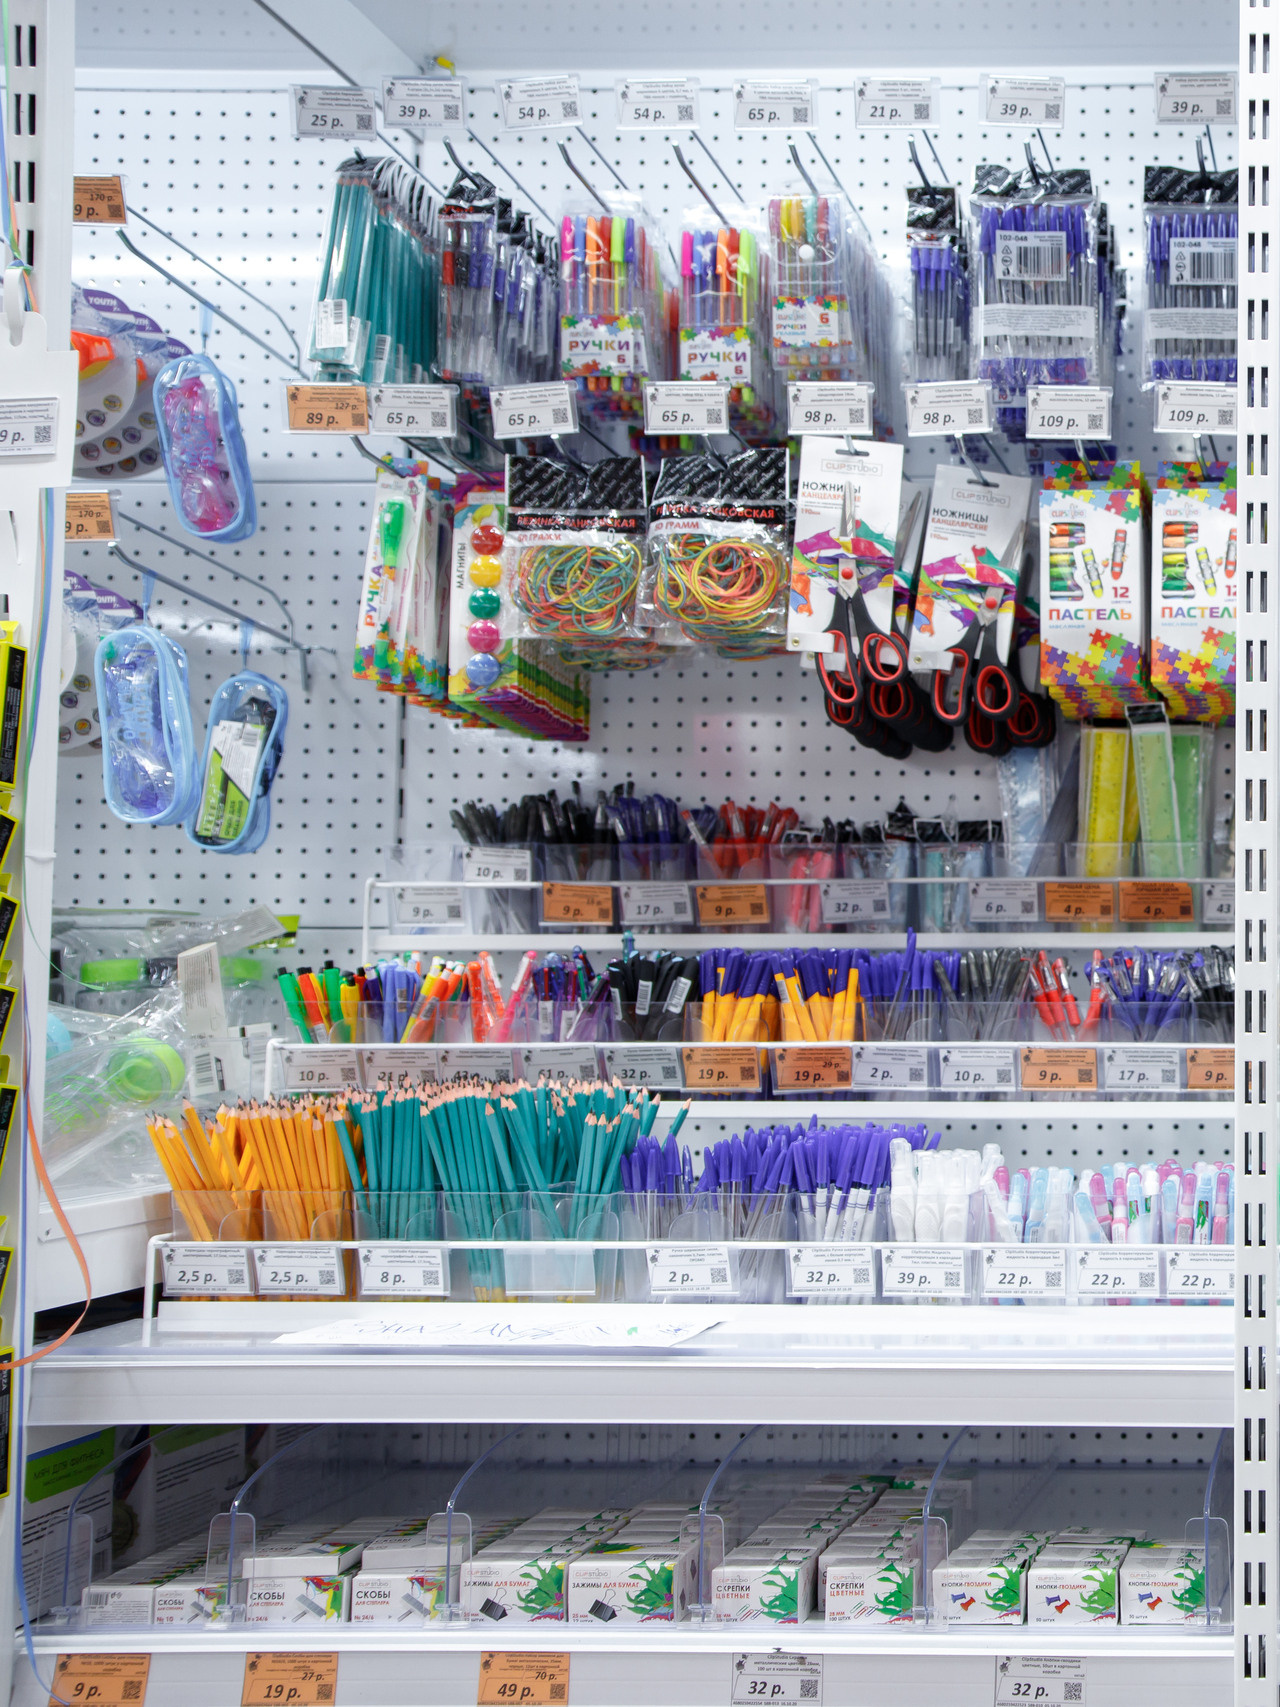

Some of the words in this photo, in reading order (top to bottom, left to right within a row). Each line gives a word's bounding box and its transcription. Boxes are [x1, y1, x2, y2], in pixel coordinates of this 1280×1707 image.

[399, 105, 415, 117] 39
[419, 109, 430, 120] р.
[634, 108, 649, 120] 54
[653, 110, 665, 122] р.
[870, 106, 884, 117] 21
[889, 109, 901, 120] р.
[1172, 101, 1188, 113] 39
[1191, 104, 1203, 115] р.
[88, 296, 117, 306] YOUTH
[569, 340, 630, 351] РУЧКИ
[616, 354, 626, 363] 6
[687, 352, 747, 363] РУЧКИ
[734, 366, 743, 375] 6
[306, 412, 323, 424] 89
[326, 416, 338, 427] р.
[387, 412, 403, 424] 65
[406, 416, 418, 426] р.
[805, 411, 821, 422] 98
[824, 413, 836, 424] р.
[1039, 415, 1063, 427] 109
[1066, 418, 1078, 430] р.
[826, 460, 878, 474] CLIPSTUDIO
[802, 481, 861, 493] НОЖНИЫ
[956, 490, 1006, 505] CLIPSTUDIO
[933, 508, 988, 523] НОЖНИЦЫ
[665, 521, 699, 530] ГРАММ
[932, 517, 988, 531] КАНЦЕЛЯРСКИЕ
[456, 542, 466, 589] МАГНИТЫ
[364, 565, 383, 627] РУЧКА
[1112, 587, 1129, 598] 12
[1049, 608, 1132, 621] ПАСТЕЛЬ
[637, 905, 650, 915] 17
[653, 906, 663, 916] р.
[300, 1070, 314, 1081] 10
[318, 1072, 329, 1083] р.
[955, 1071, 970, 1081] 10
[973, 1073, 984, 1083] р.
[178, 1270, 199, 1284] 2,5
[204, 1273, 216, 1284] р.
[380, 1271, 389, 1283] 8
[393, 1274, 405, 1285] р.
[806, 1271, 823, 1283] 32
[827, 1273, 840, 1285] р.
[1182, 1275, 1199, 1286] 22
[1203, 1278, 1215, 1289] р.
[33, 1469, 51, 1481] МЯЧ
[52, 1462, 68, 1475] ДЛЯ
[69, 1448, 105, 1470] ФИТНЕСА
[250, 1592, 285, 1601] СКОБЫ
[356, 1591, 391, 1599] СКОБЫ
[157, 1599, 185, 1607] СКОБЫ
[73, 1682, 84, 1697] 9
[86, 1686, 101, 1700] р.
[497, 1683, 517, 1697] 49
[520, 1687, 534, 1700] р.
[748, 1681, 767, 1694] 32
[771, 1684, 784, 1698] р.
[1012, 1683, 1031, 1696] 32
[1035, 1687, 1048, 1699] р.
